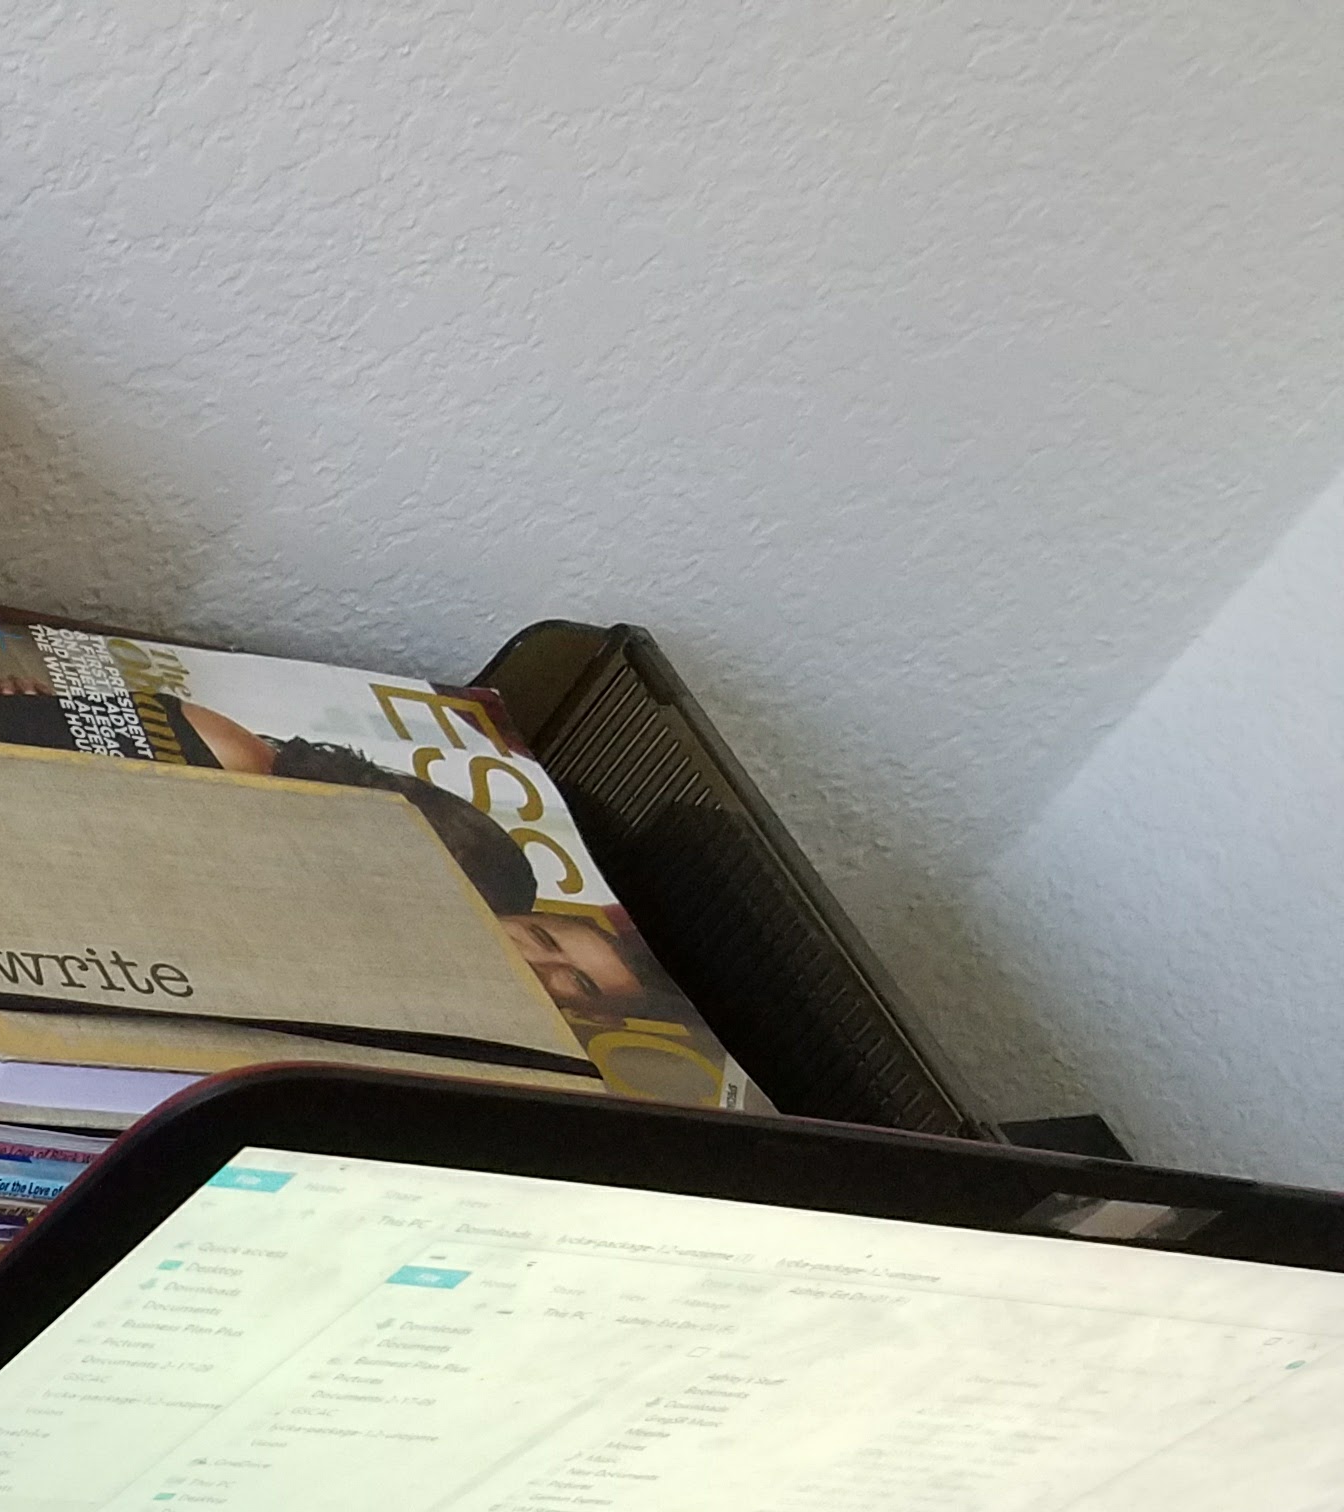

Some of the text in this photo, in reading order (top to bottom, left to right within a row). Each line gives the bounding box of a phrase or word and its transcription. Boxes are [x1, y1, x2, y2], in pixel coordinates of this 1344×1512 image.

[28, 624, 92, 755] THE WHITE HOU
[42, 625, 107, 756] AND LIFE AFTER
[71, 656, 102, 702] THEIR
[90, 705, 125, 758] LEGAC
[80, 644, 130, 739] FIRST LADY
[105, 666, 153, 759] PRESIDENT
[12, 1180, 26, 1193] the
[29, 1182, 50, 1196] Love
